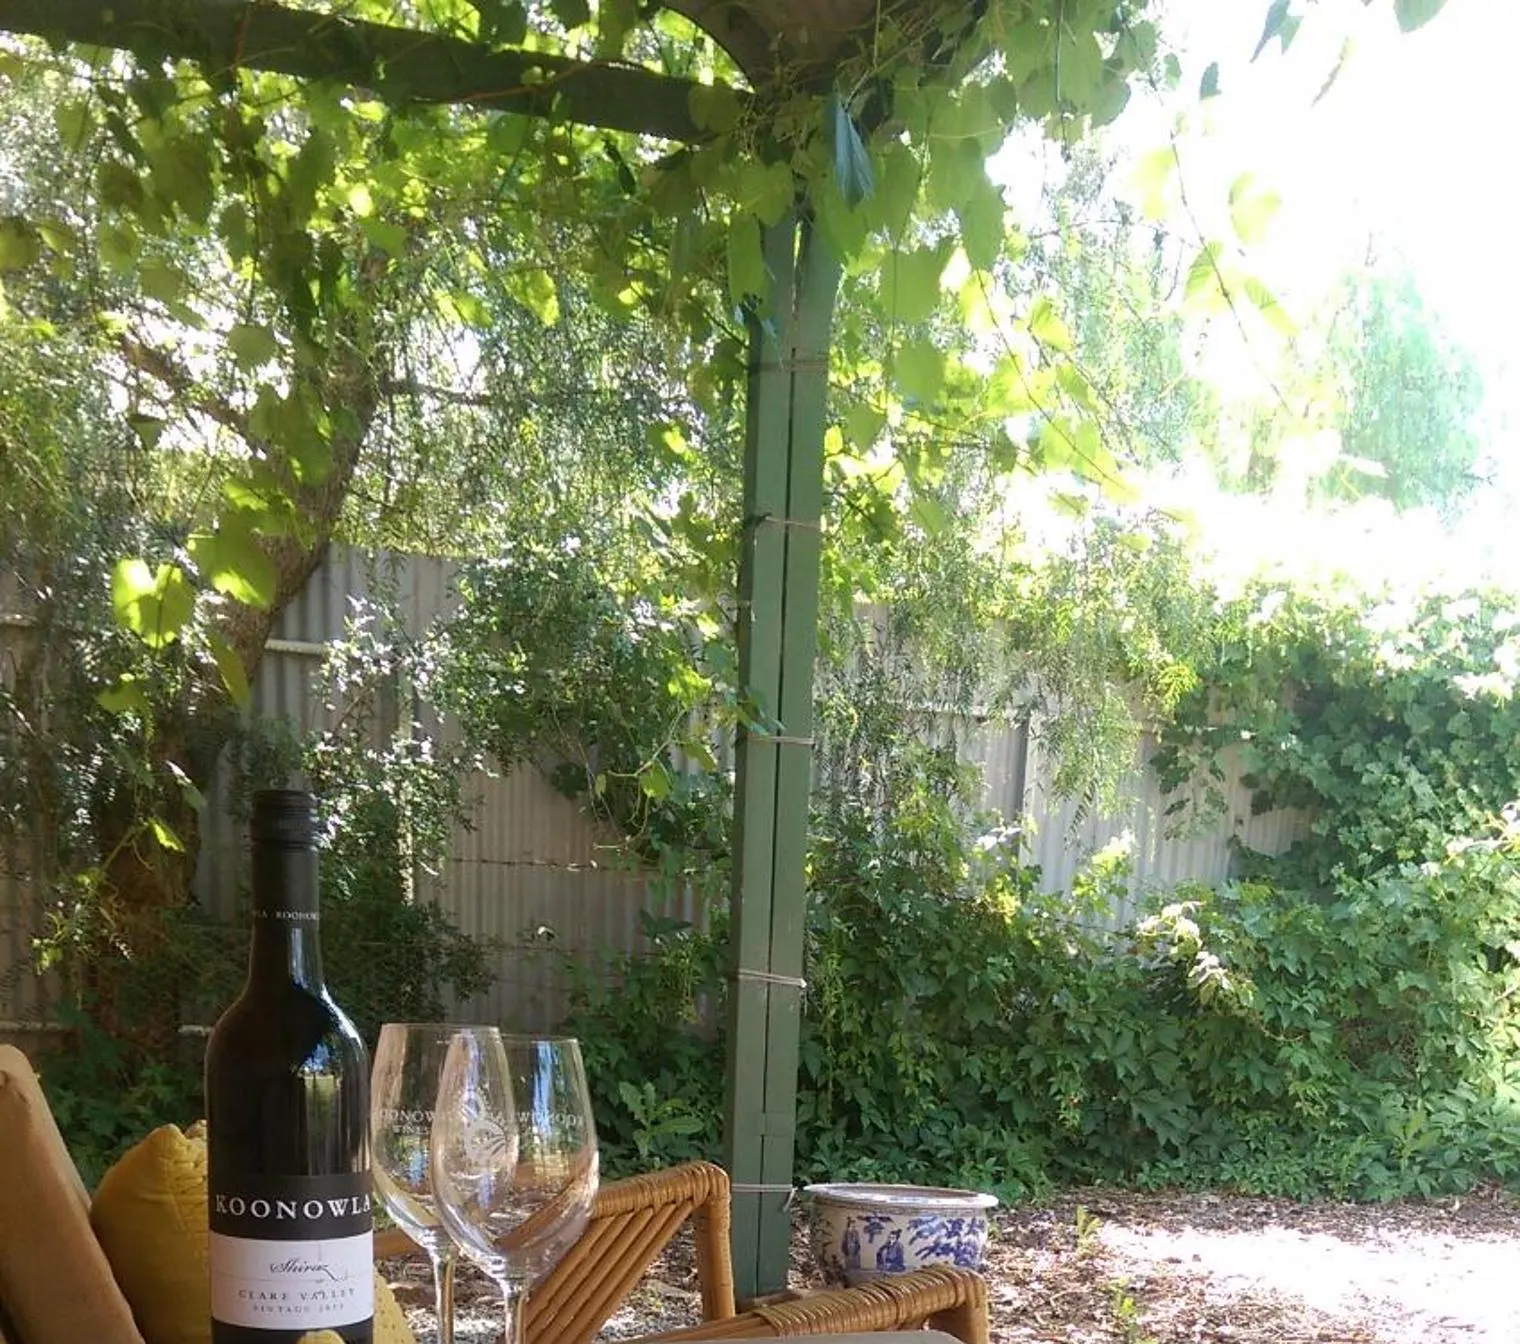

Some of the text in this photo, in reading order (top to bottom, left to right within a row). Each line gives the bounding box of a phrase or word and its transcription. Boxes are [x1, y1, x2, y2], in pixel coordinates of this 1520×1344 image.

[215, 1193, 371, 1220] KOONOWLA
[270, 1258, 338, 1282] Shiraz
[238, 1286, 354, 1301] CLARE VALLEY
